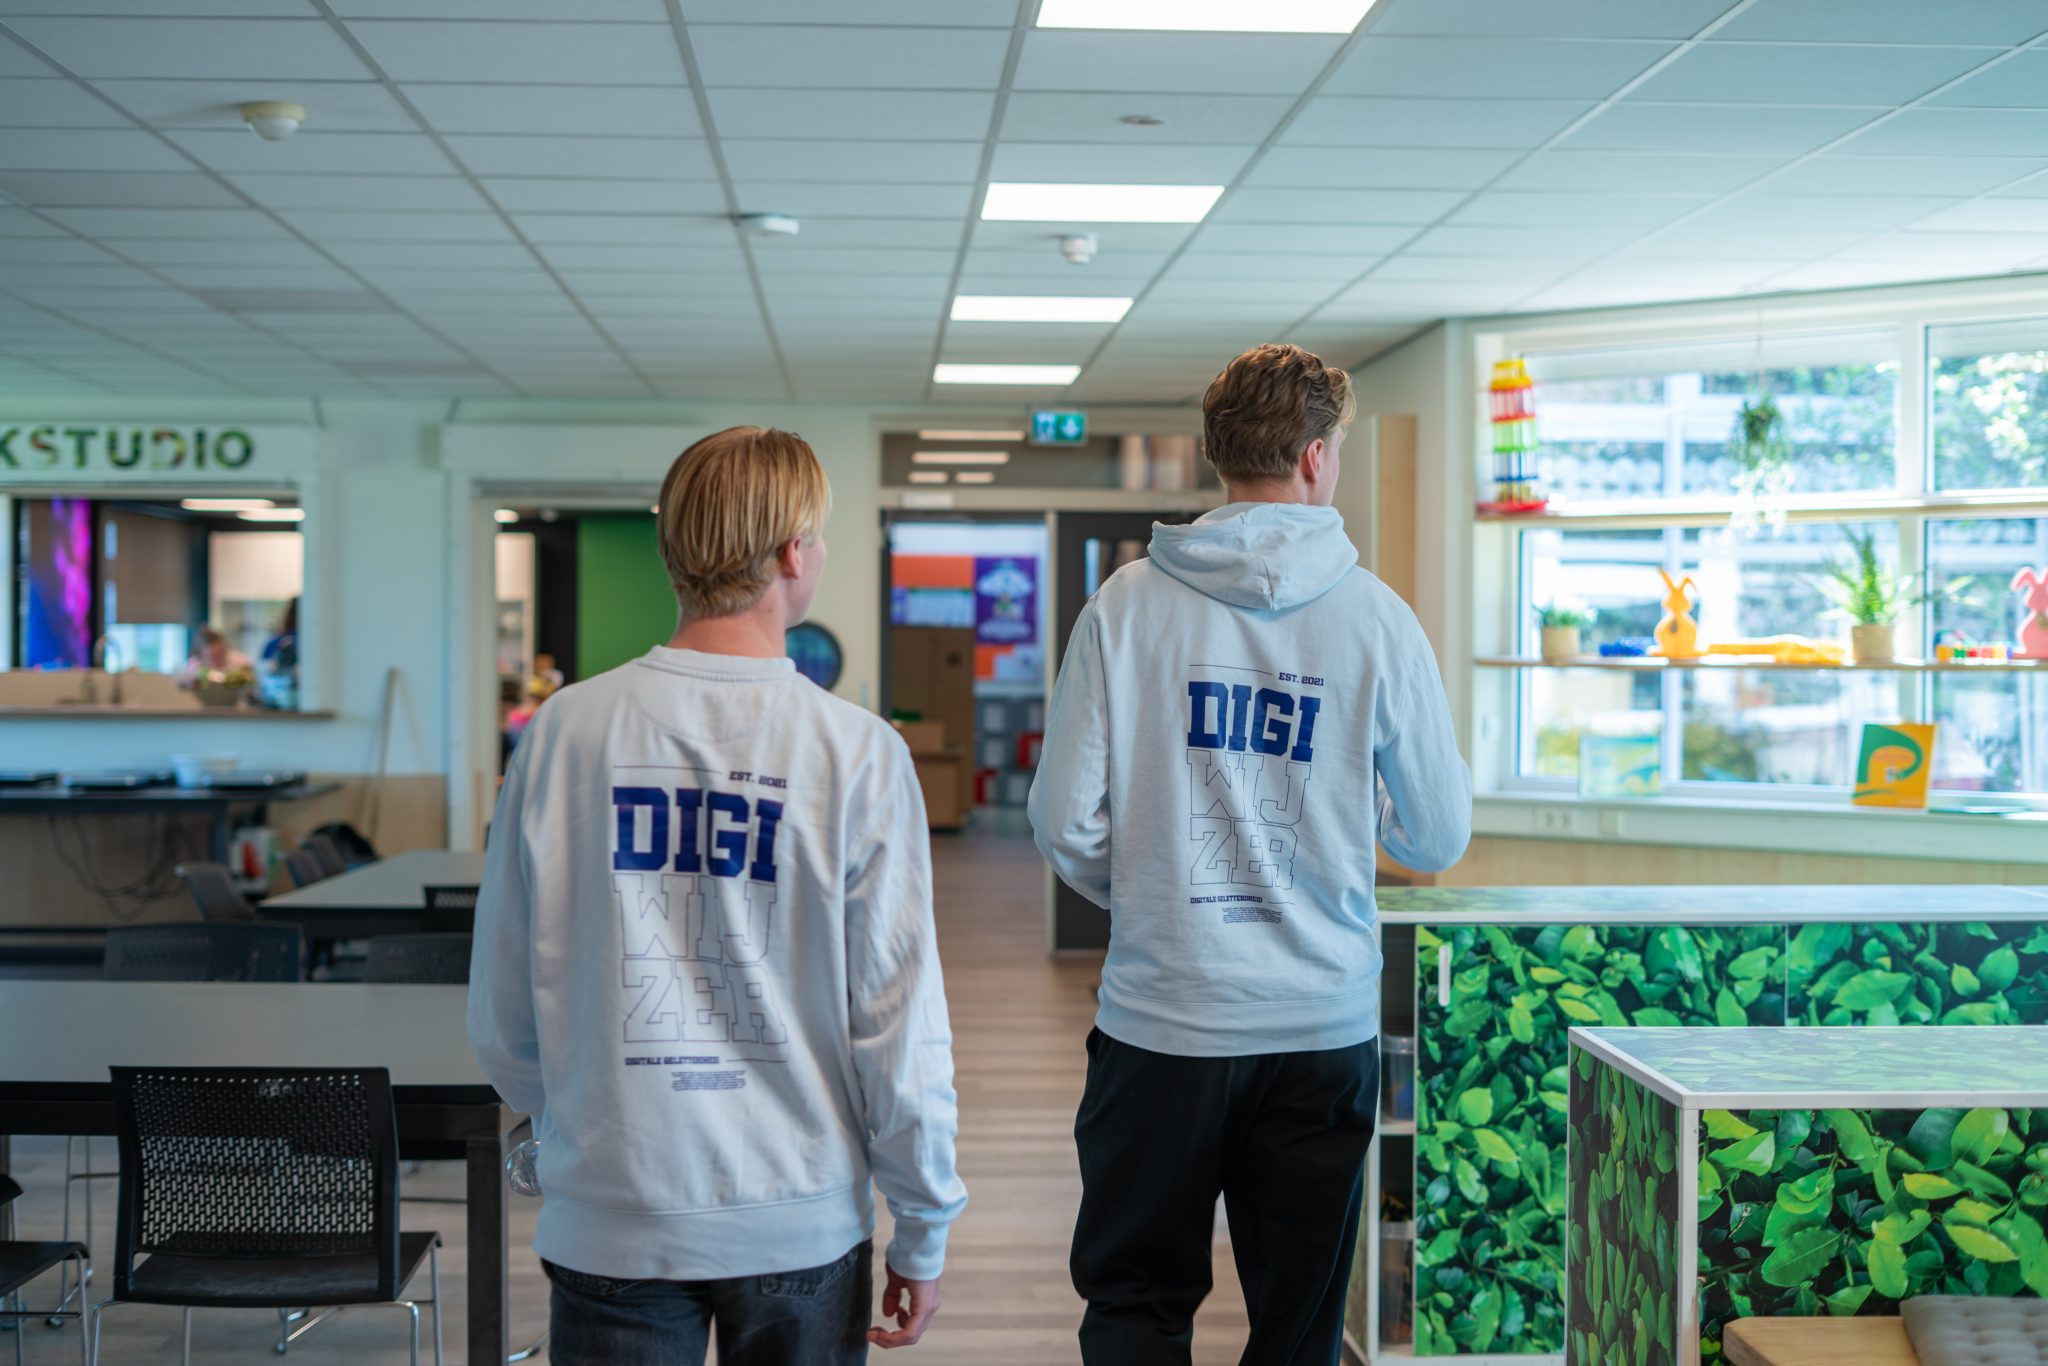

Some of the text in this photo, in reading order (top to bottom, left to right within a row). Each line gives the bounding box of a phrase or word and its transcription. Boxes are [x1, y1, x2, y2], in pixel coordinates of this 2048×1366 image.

[1278, 671, 1324, 687] EST. 2021
[1187, 681, 1321, 762] DIGI
[729, 770, 755, 782] EST.
[1187, 749, 1311, 826] WIJ
[612, 786, 784, 883] DIGI
[1190, 817, 1298, 891] ZER
[612, 873, 777, 965] WIJ
[622, 957, 788, 1045] ZER
